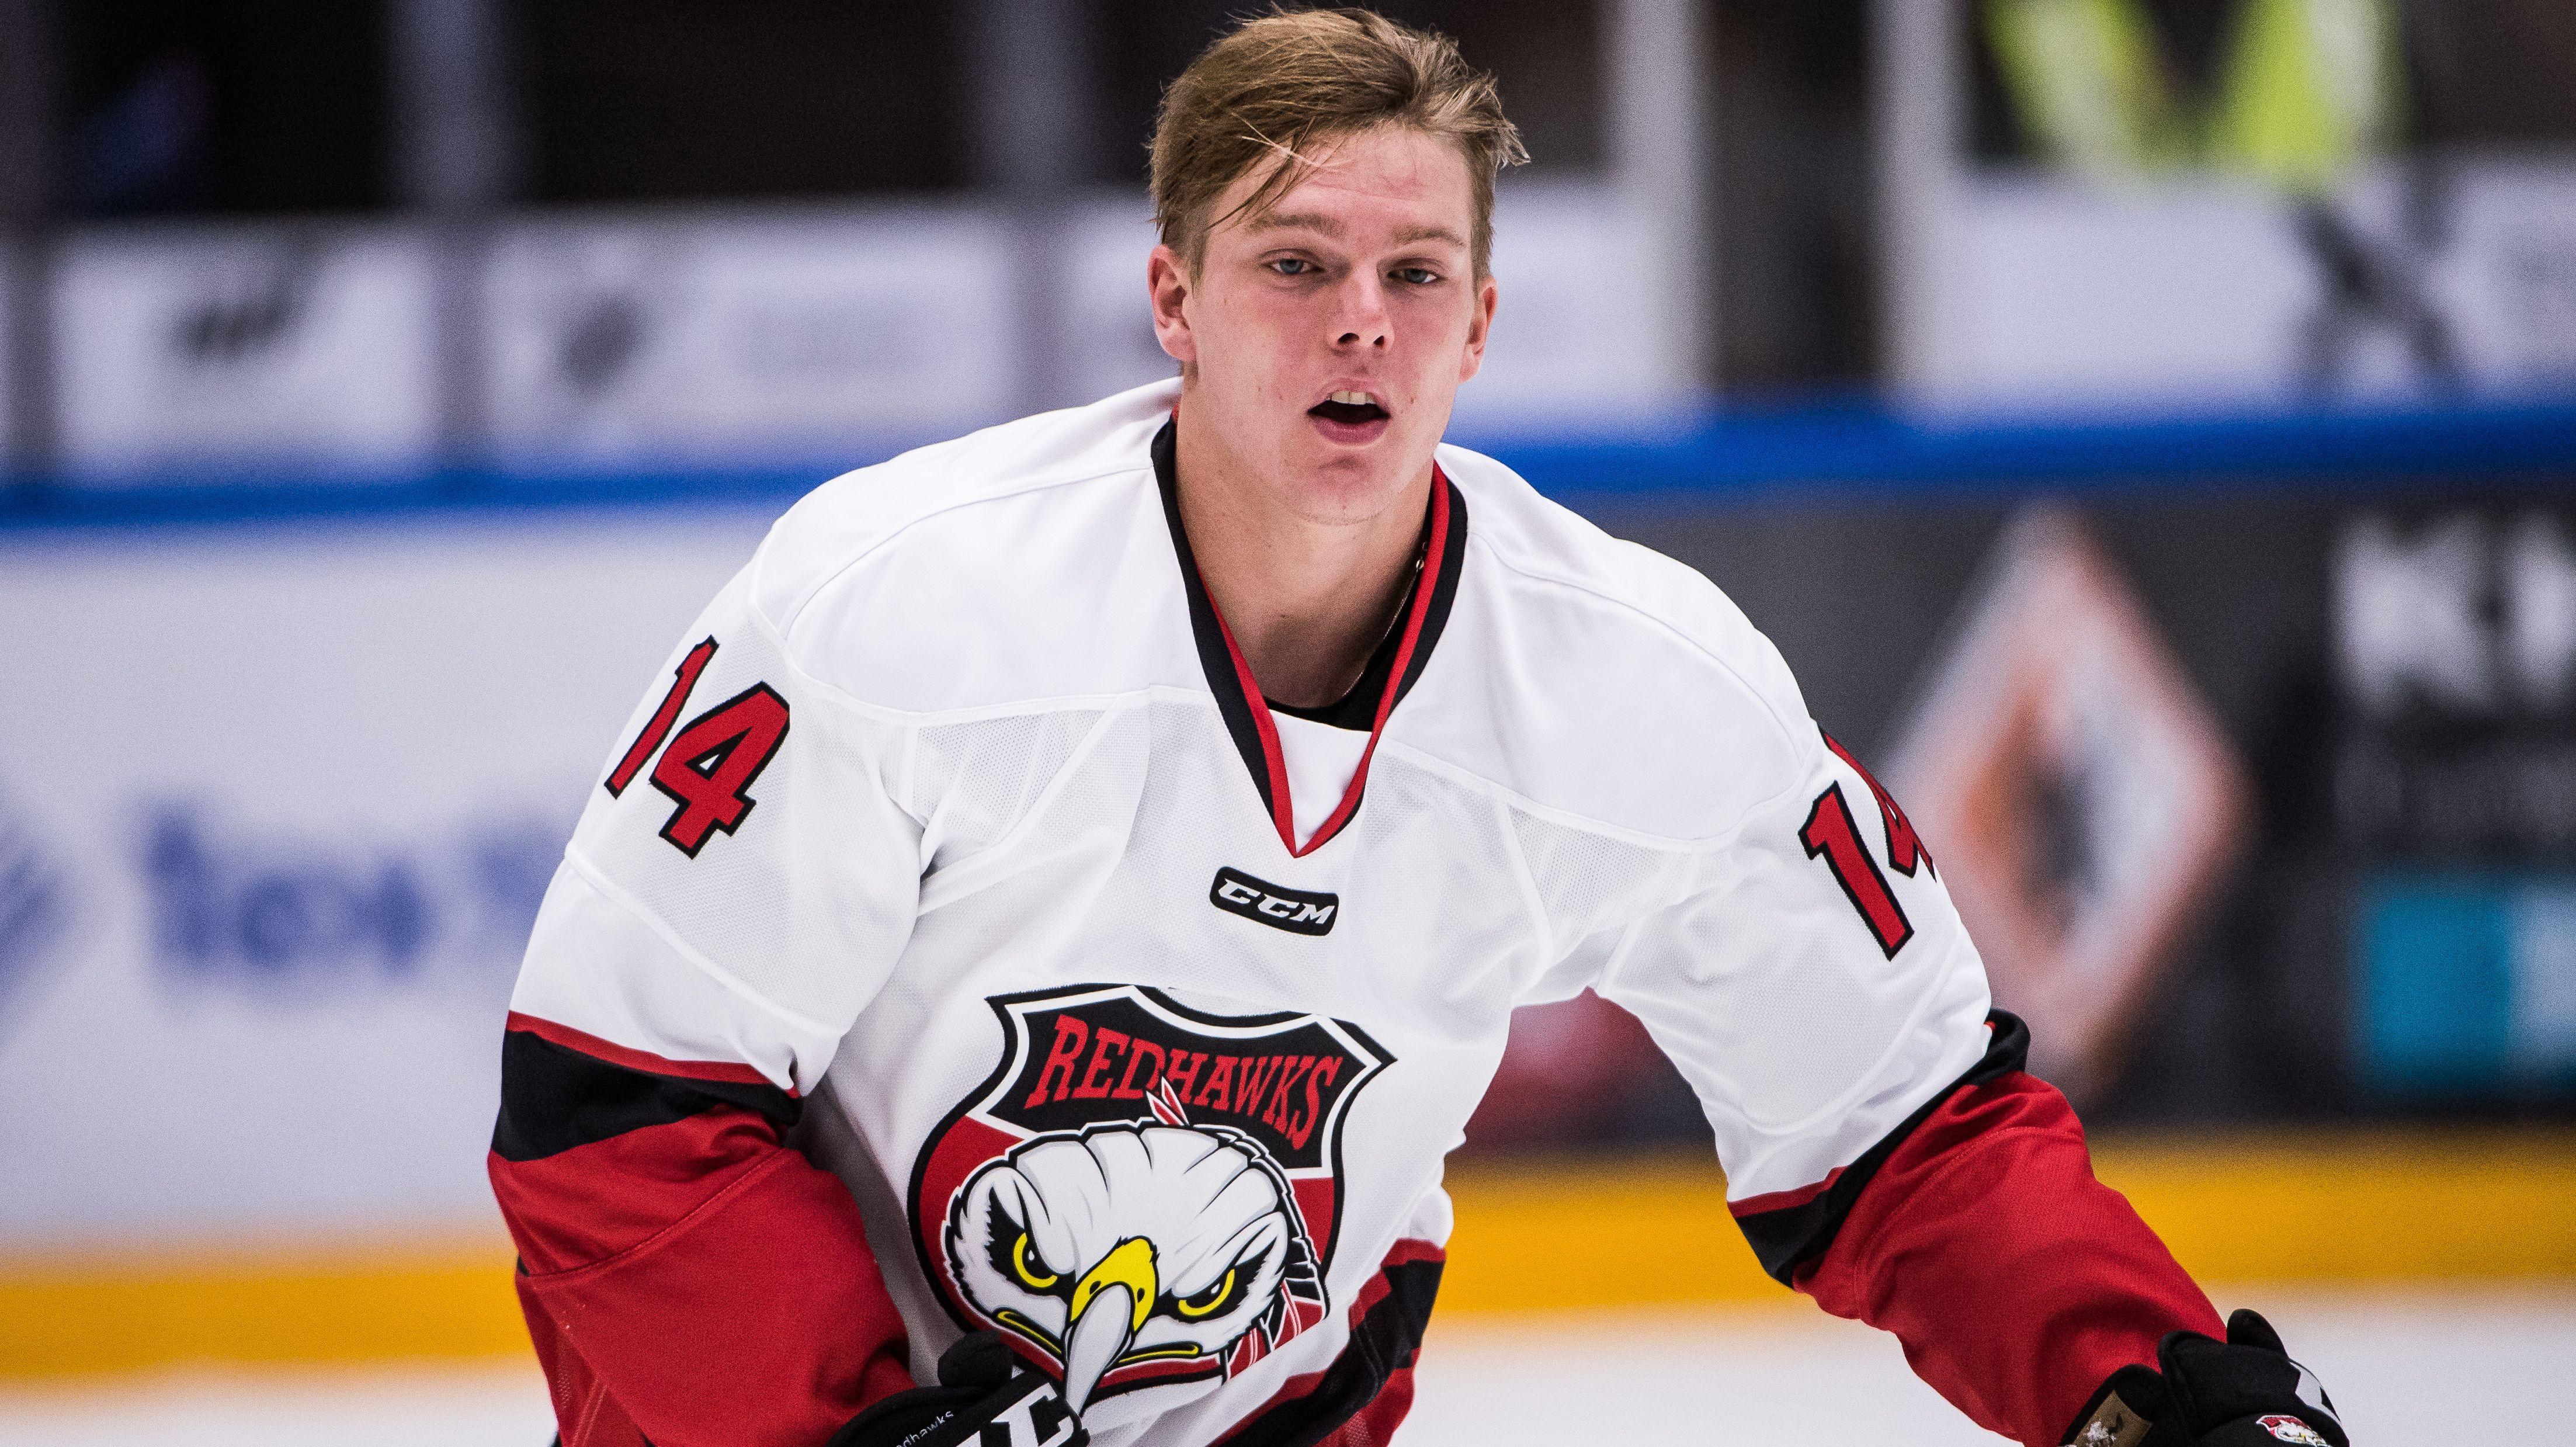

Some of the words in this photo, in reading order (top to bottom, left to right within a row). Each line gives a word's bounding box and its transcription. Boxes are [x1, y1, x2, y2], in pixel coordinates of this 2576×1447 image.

[604, 634, 790, 860] 14
[1218, 878, 1335, 925] CCM
[1024, 1014, 1343, 1151] REDHAWKS
